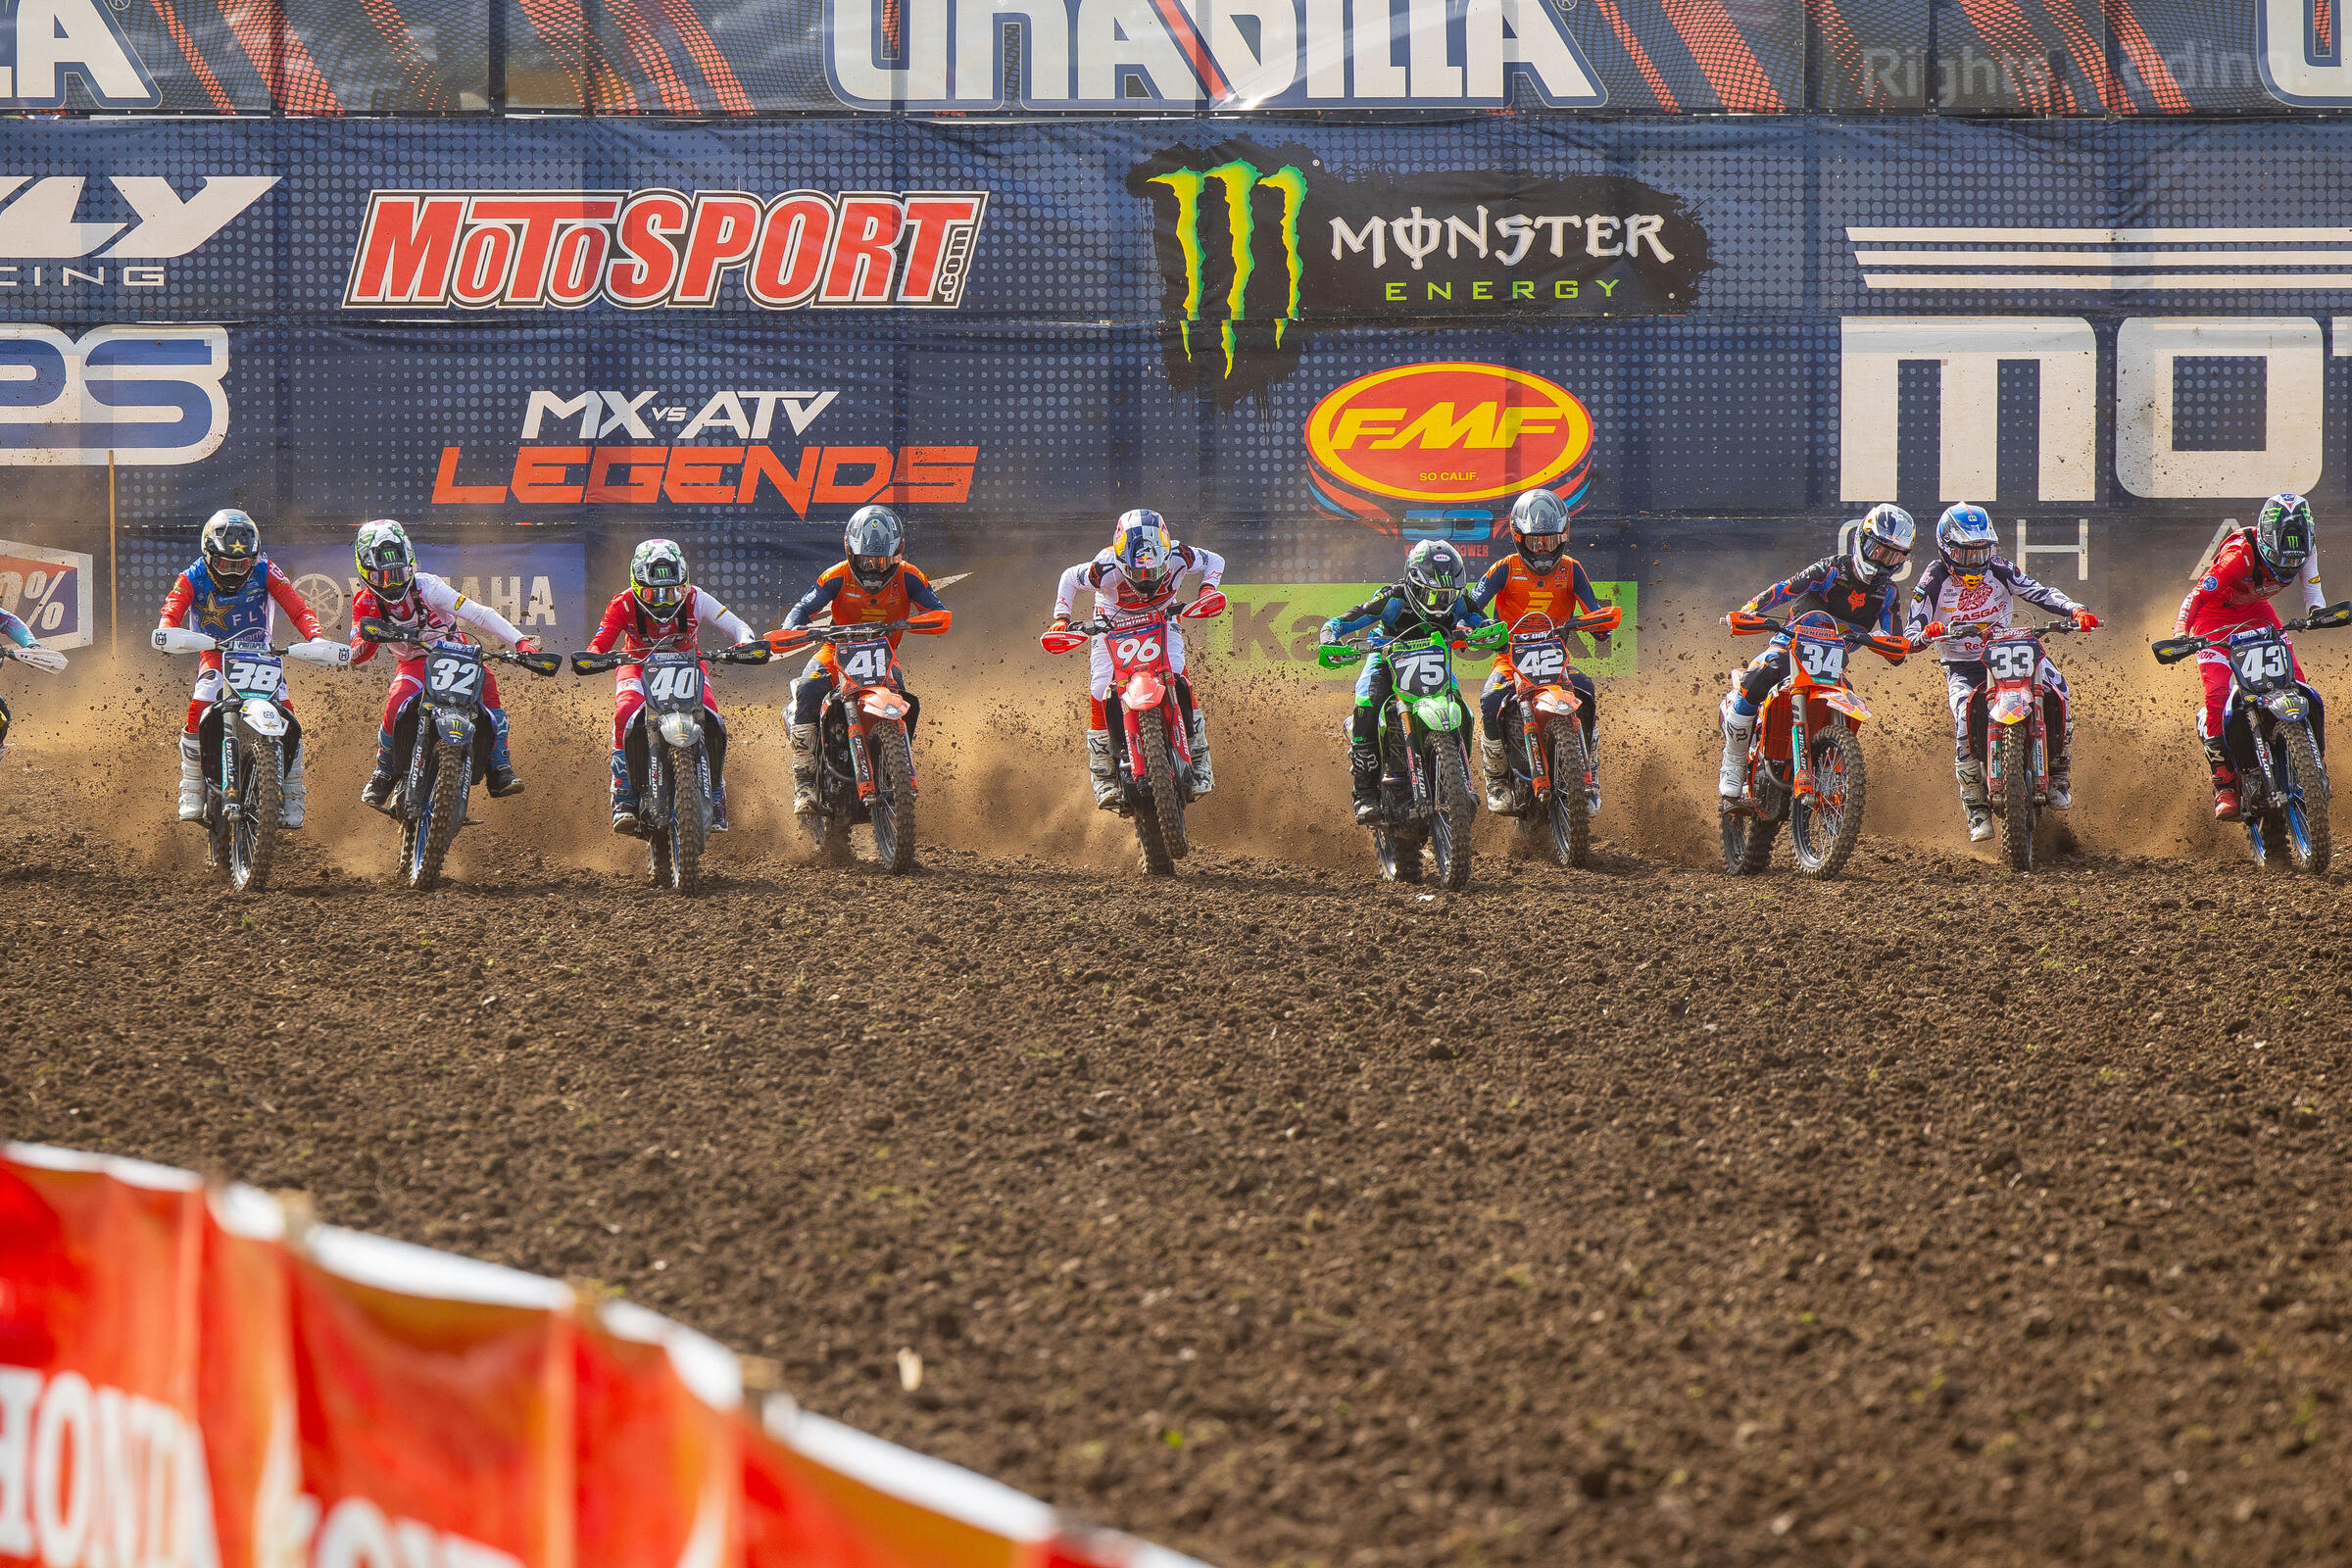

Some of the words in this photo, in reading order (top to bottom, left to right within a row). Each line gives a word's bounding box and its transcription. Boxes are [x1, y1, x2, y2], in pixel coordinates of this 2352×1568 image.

[0, 175, 282, 259] LY
[1328, 204, 1675, 270] MONSTER
[1385, 278, 1620, 302] ENERGY
[520, 390, 660, 439] MX
[676, 390, 840, 440] ATV
[1330, 401, 1574, 450] FMF
[430, 445, 979, 521] LEGENDS
[1419, 471, 1438, 482] SO
[1440, 471, 1481, 482] CALIF.
[1950, 601, 2005, 622] GASGAS
[844, 648, 888, 679] 41
[1115, 634, 1161, 669] 96
[1517, 648, 1564, 677] 42
[1802, 644, 1844, 679] 34
[1990, 645, 2034, 680] 33
[2240, 645, 2287, 683] 43
[228, 662, 282, 692] 38
[430, 658, 479, 696] 32
[650, 666, 700, 702] 40
[1395, 654, 1445, 691] 75
[1124, 729, 1135, 770] DUNLOP
[1177, 714, 1190, 756] DUNLOP
[410, 745, 423, 789] DUNLOP
[2255, 736, 2272, 778] DUNLOP
[700, 756, 710, 800] DUNLOP
